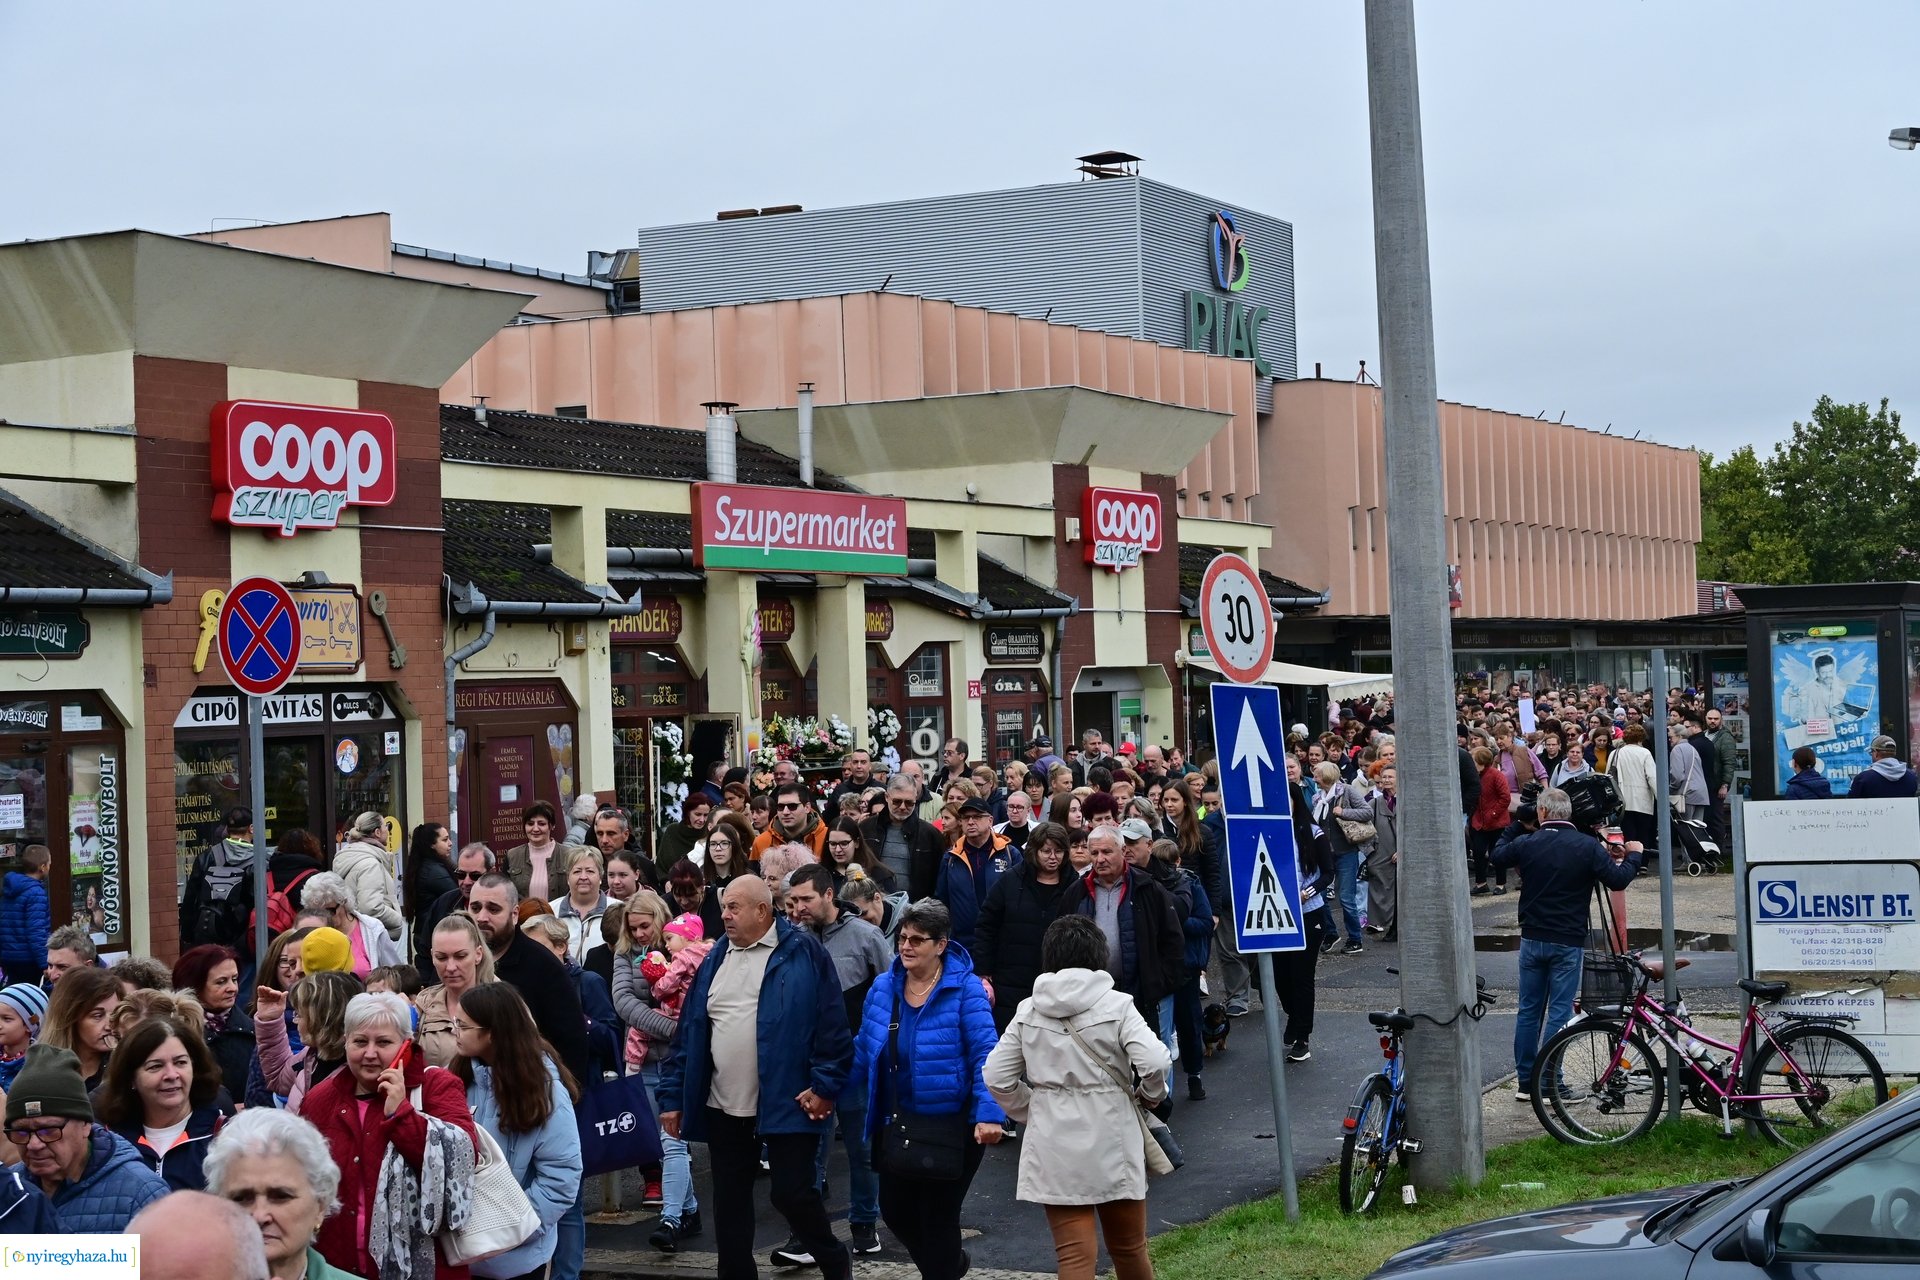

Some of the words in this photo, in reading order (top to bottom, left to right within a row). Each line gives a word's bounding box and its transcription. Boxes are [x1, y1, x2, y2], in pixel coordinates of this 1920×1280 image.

[1186, 290, 1272, 377] PIAC
[239, 421, 383, 502] coop
[233, 490, 345, 530] szuper
[1097, 498, 1155, 548] coop
[714, 495, 896, 555] Szupermarket
[1095, 542, 1141, 567] szuper
[1221, 593, 1254, 645] 30
[456, 690, 475, 707] RÉGI
[478, 689, 500, 706] PÉNZ
[502, 687, 555, 706] FELVÁSÁRLÁS
[995, 679, 1022, 691] ÓRA
[191, 697, 237, 722] CIPŐ
[262, 695, 322, 718] AVÍTÁS
[343, 701, 360, 709] KULCS
[1816, 736, 1866, 754] angyal!
[1801, 895, 1875, 917] LENSIT
[1882, 894, 1913, 917] BT.
[1837, 998, 1875, 1006] KÉPZÉS
